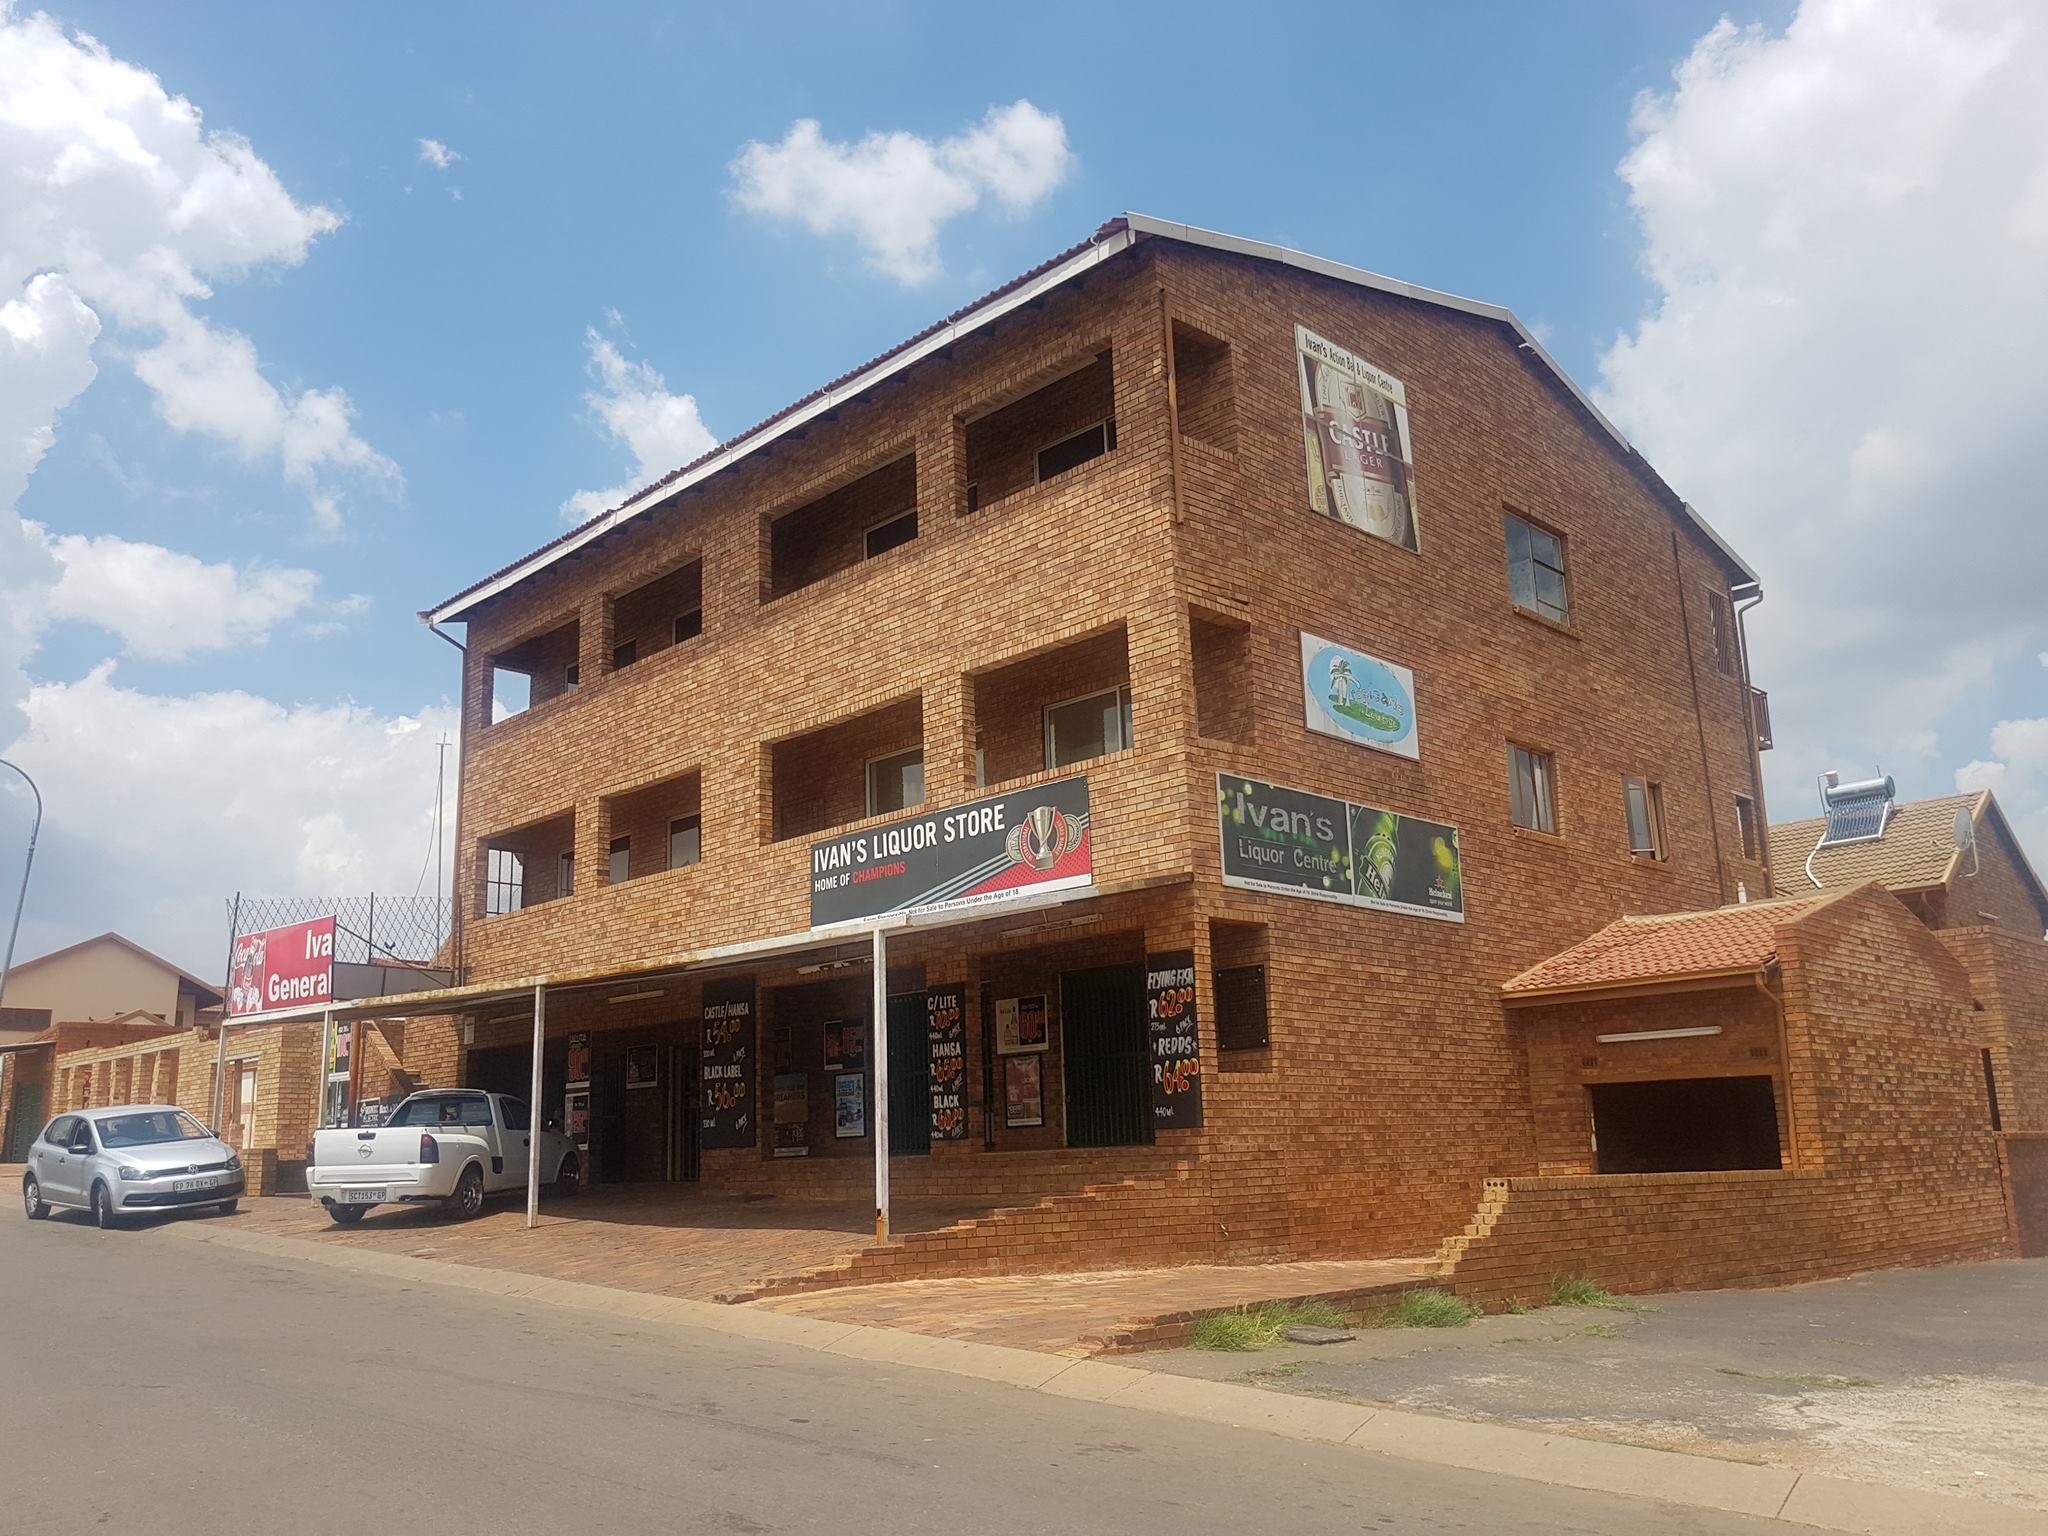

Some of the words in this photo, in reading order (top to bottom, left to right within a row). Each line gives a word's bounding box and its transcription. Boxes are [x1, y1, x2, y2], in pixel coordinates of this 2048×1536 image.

[1305, 334, 1327, 358] Ivan's
[1330, 348, 1345, 368] Action
[1328, 420, 1388, 456] CASTLE
[1236, 791, 1334, 841] Ivan's
[814, 838, 868, 874] IVAN'S
[873, 821, 938, 860] LIQUOR
[944, 804, 1006, 843] STORE
[1238, 838, 1284, 866] Liquor
[1294, 848, 1337, 874] Centre
[814, 875, 838, 893] HOME
[840, 872, 850, 886] OF
[852, 860, 906, 884] CHAMPIONS
[926, 904, 938, 912] Sale
[944, 900, 966, 909] Persons
[966, 896, 982, 905] Under
[983, 894, 992, 902] the
[993, 892, 1004, 903] Age
[1005, 890, 1011, 898] of
[268, 964, 332, 1002] General
[1148, 969, 1176, 990] FLYING
[1176, 967, 1194, 986] FISH
[932, 1041, 962, 1058] HANSA
[1158, 1036, 1192, 1056] REDDS
[704, 1066, 722, 1080] BLACK
[723, 1064, 742, 1078] LABEL
[933, 1094, 960, 1109] BLACK
